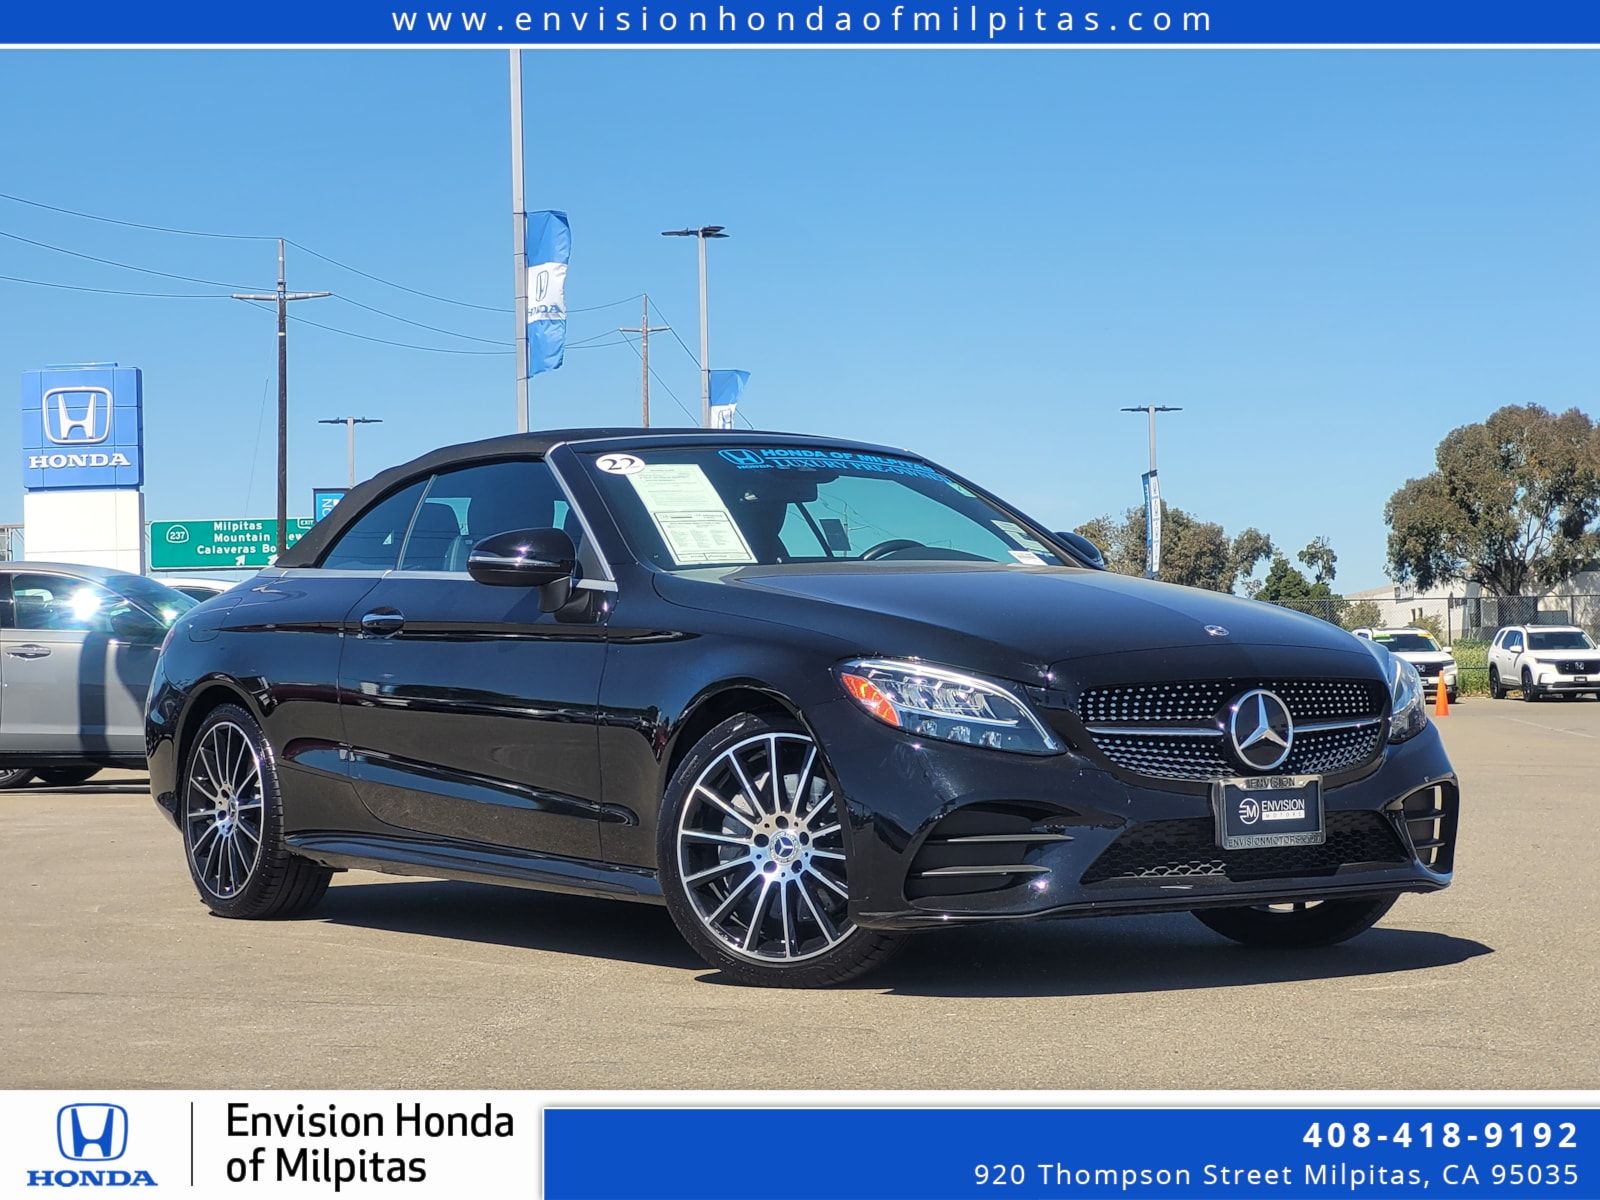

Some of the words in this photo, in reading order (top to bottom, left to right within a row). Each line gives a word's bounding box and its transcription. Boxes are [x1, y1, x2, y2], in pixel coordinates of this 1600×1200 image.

[759, 449, 828, 459] HONDA
[830, 451, 852, 460] OF
[29, 452, 131, 470] HONDA
[601, 457, 637, 471] 22
[773, 459, 848, 470] LUXURY
[213, 521, 262, 532] Milpitas
[169, 531, 185, 540] 237
[213, 533, 270, 542] Mountain
[197, 544, 256, 554] Calaveras
[1261, 799, 1305, 812] ENVISION
